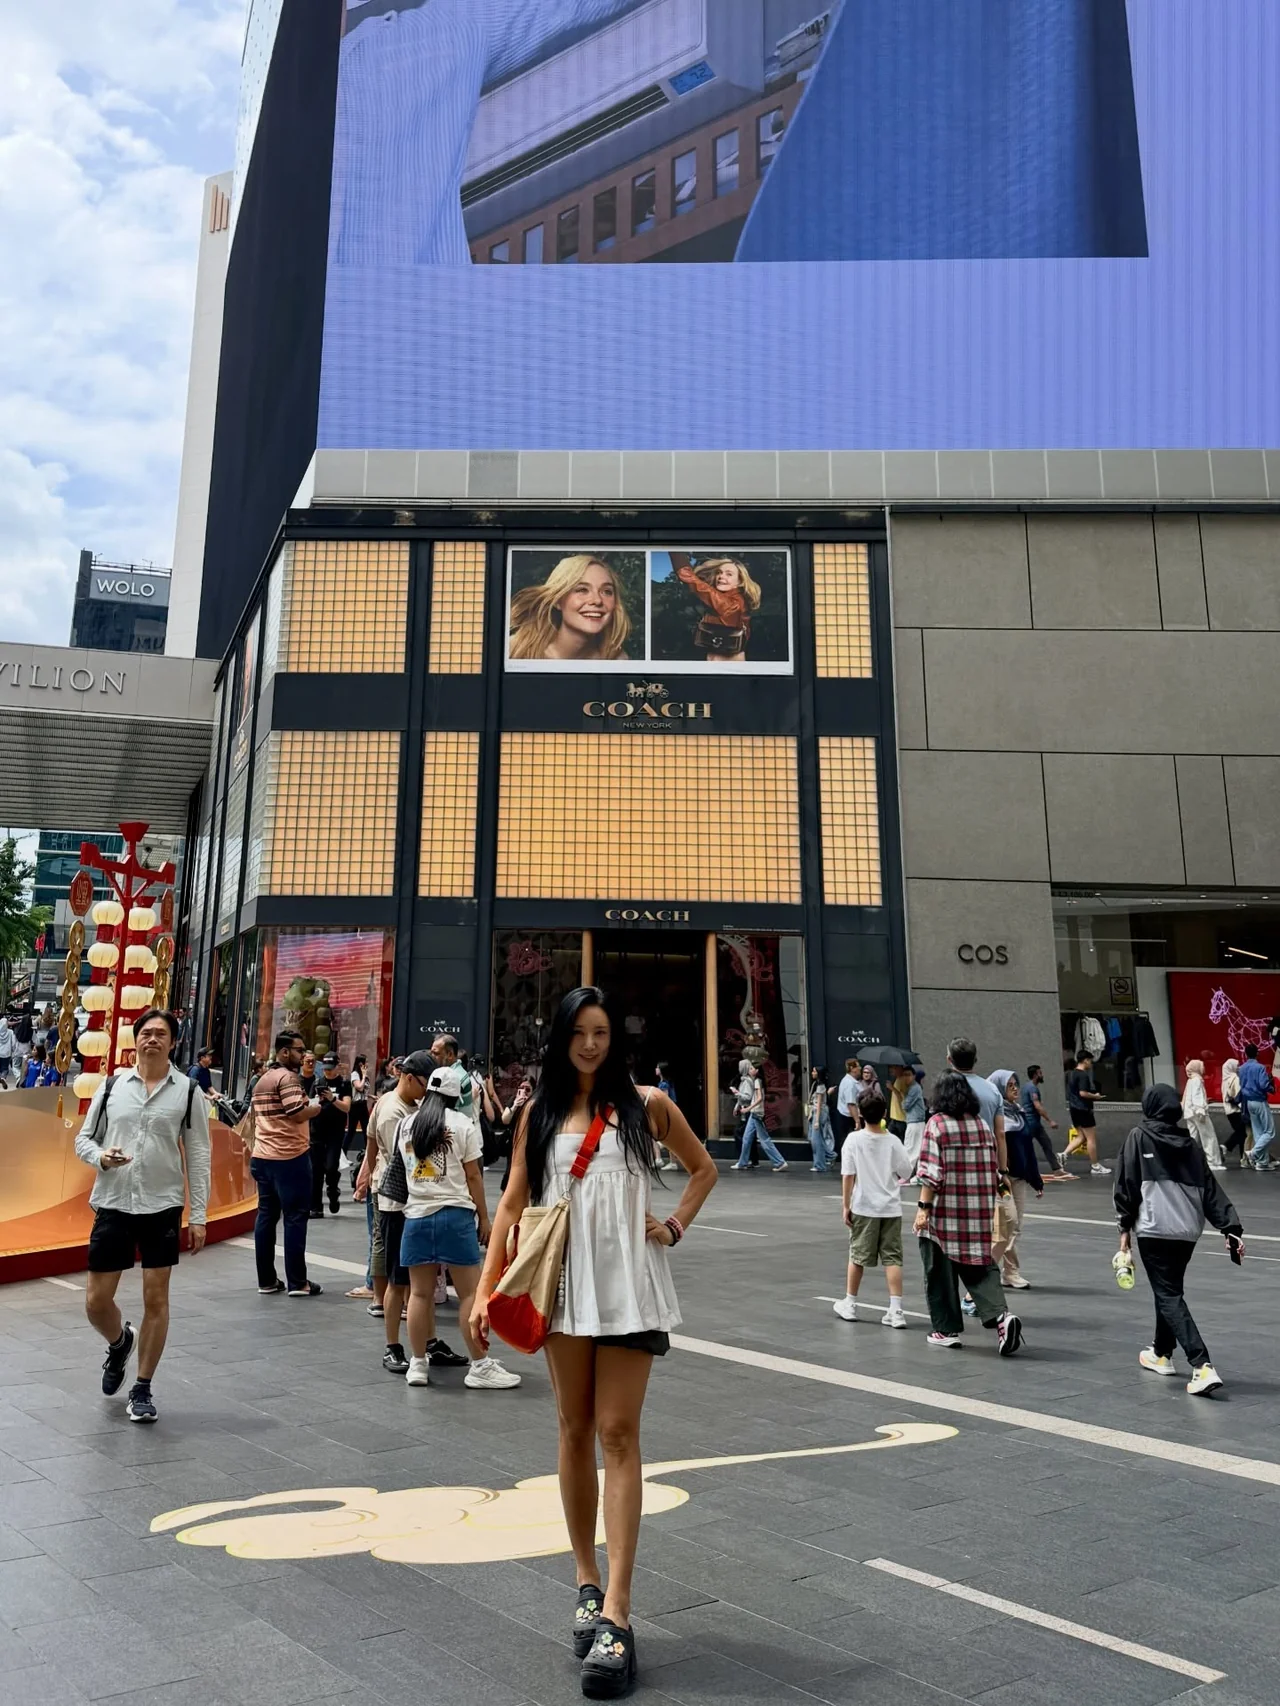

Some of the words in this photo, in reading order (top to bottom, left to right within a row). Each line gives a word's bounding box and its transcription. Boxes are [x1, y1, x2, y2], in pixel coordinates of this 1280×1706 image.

[96, 578, 156, 598] WOLO
[582, 701, 713, 718] COACH
[605, 909, 690, 921] COACH
[957, 943, 1009, 965] COS
